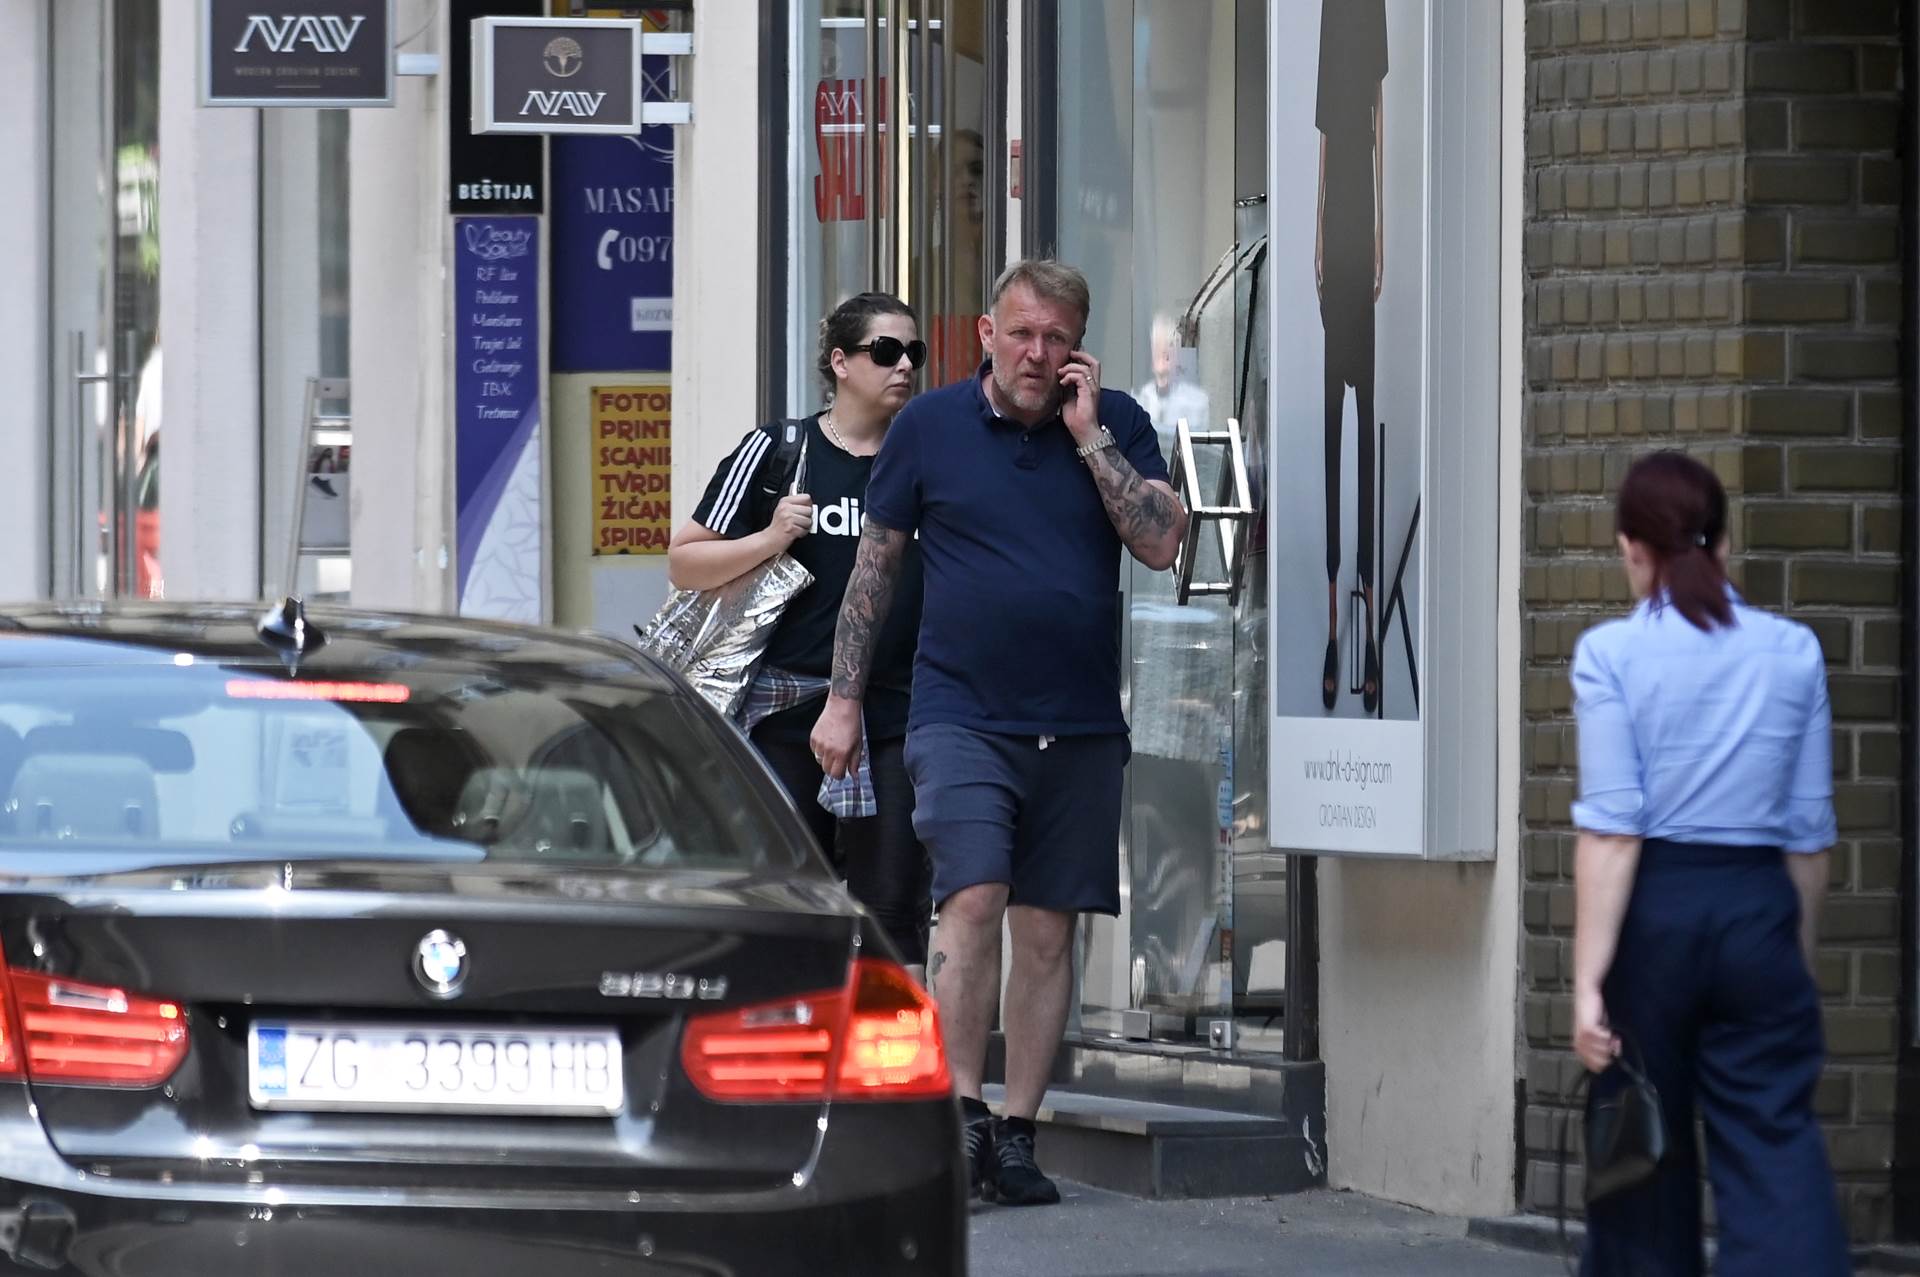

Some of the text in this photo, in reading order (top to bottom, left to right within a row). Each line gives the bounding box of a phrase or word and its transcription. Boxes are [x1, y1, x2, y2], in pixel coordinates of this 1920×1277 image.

[235, 16, 366, 52] NAV
[518, 91, 606, 116] NAV
[458, 179, 534, 200] BEŠTIJA
[619, 236, 672, 262] 097
[482, 382, 512, 396] IBX
[600, 420, 671, 441] PRINT
[297, 1033, 358, 1089] ZG
[404, 1034, 531, 1093] 3399
[549, 1039, 610, 1093] HB
